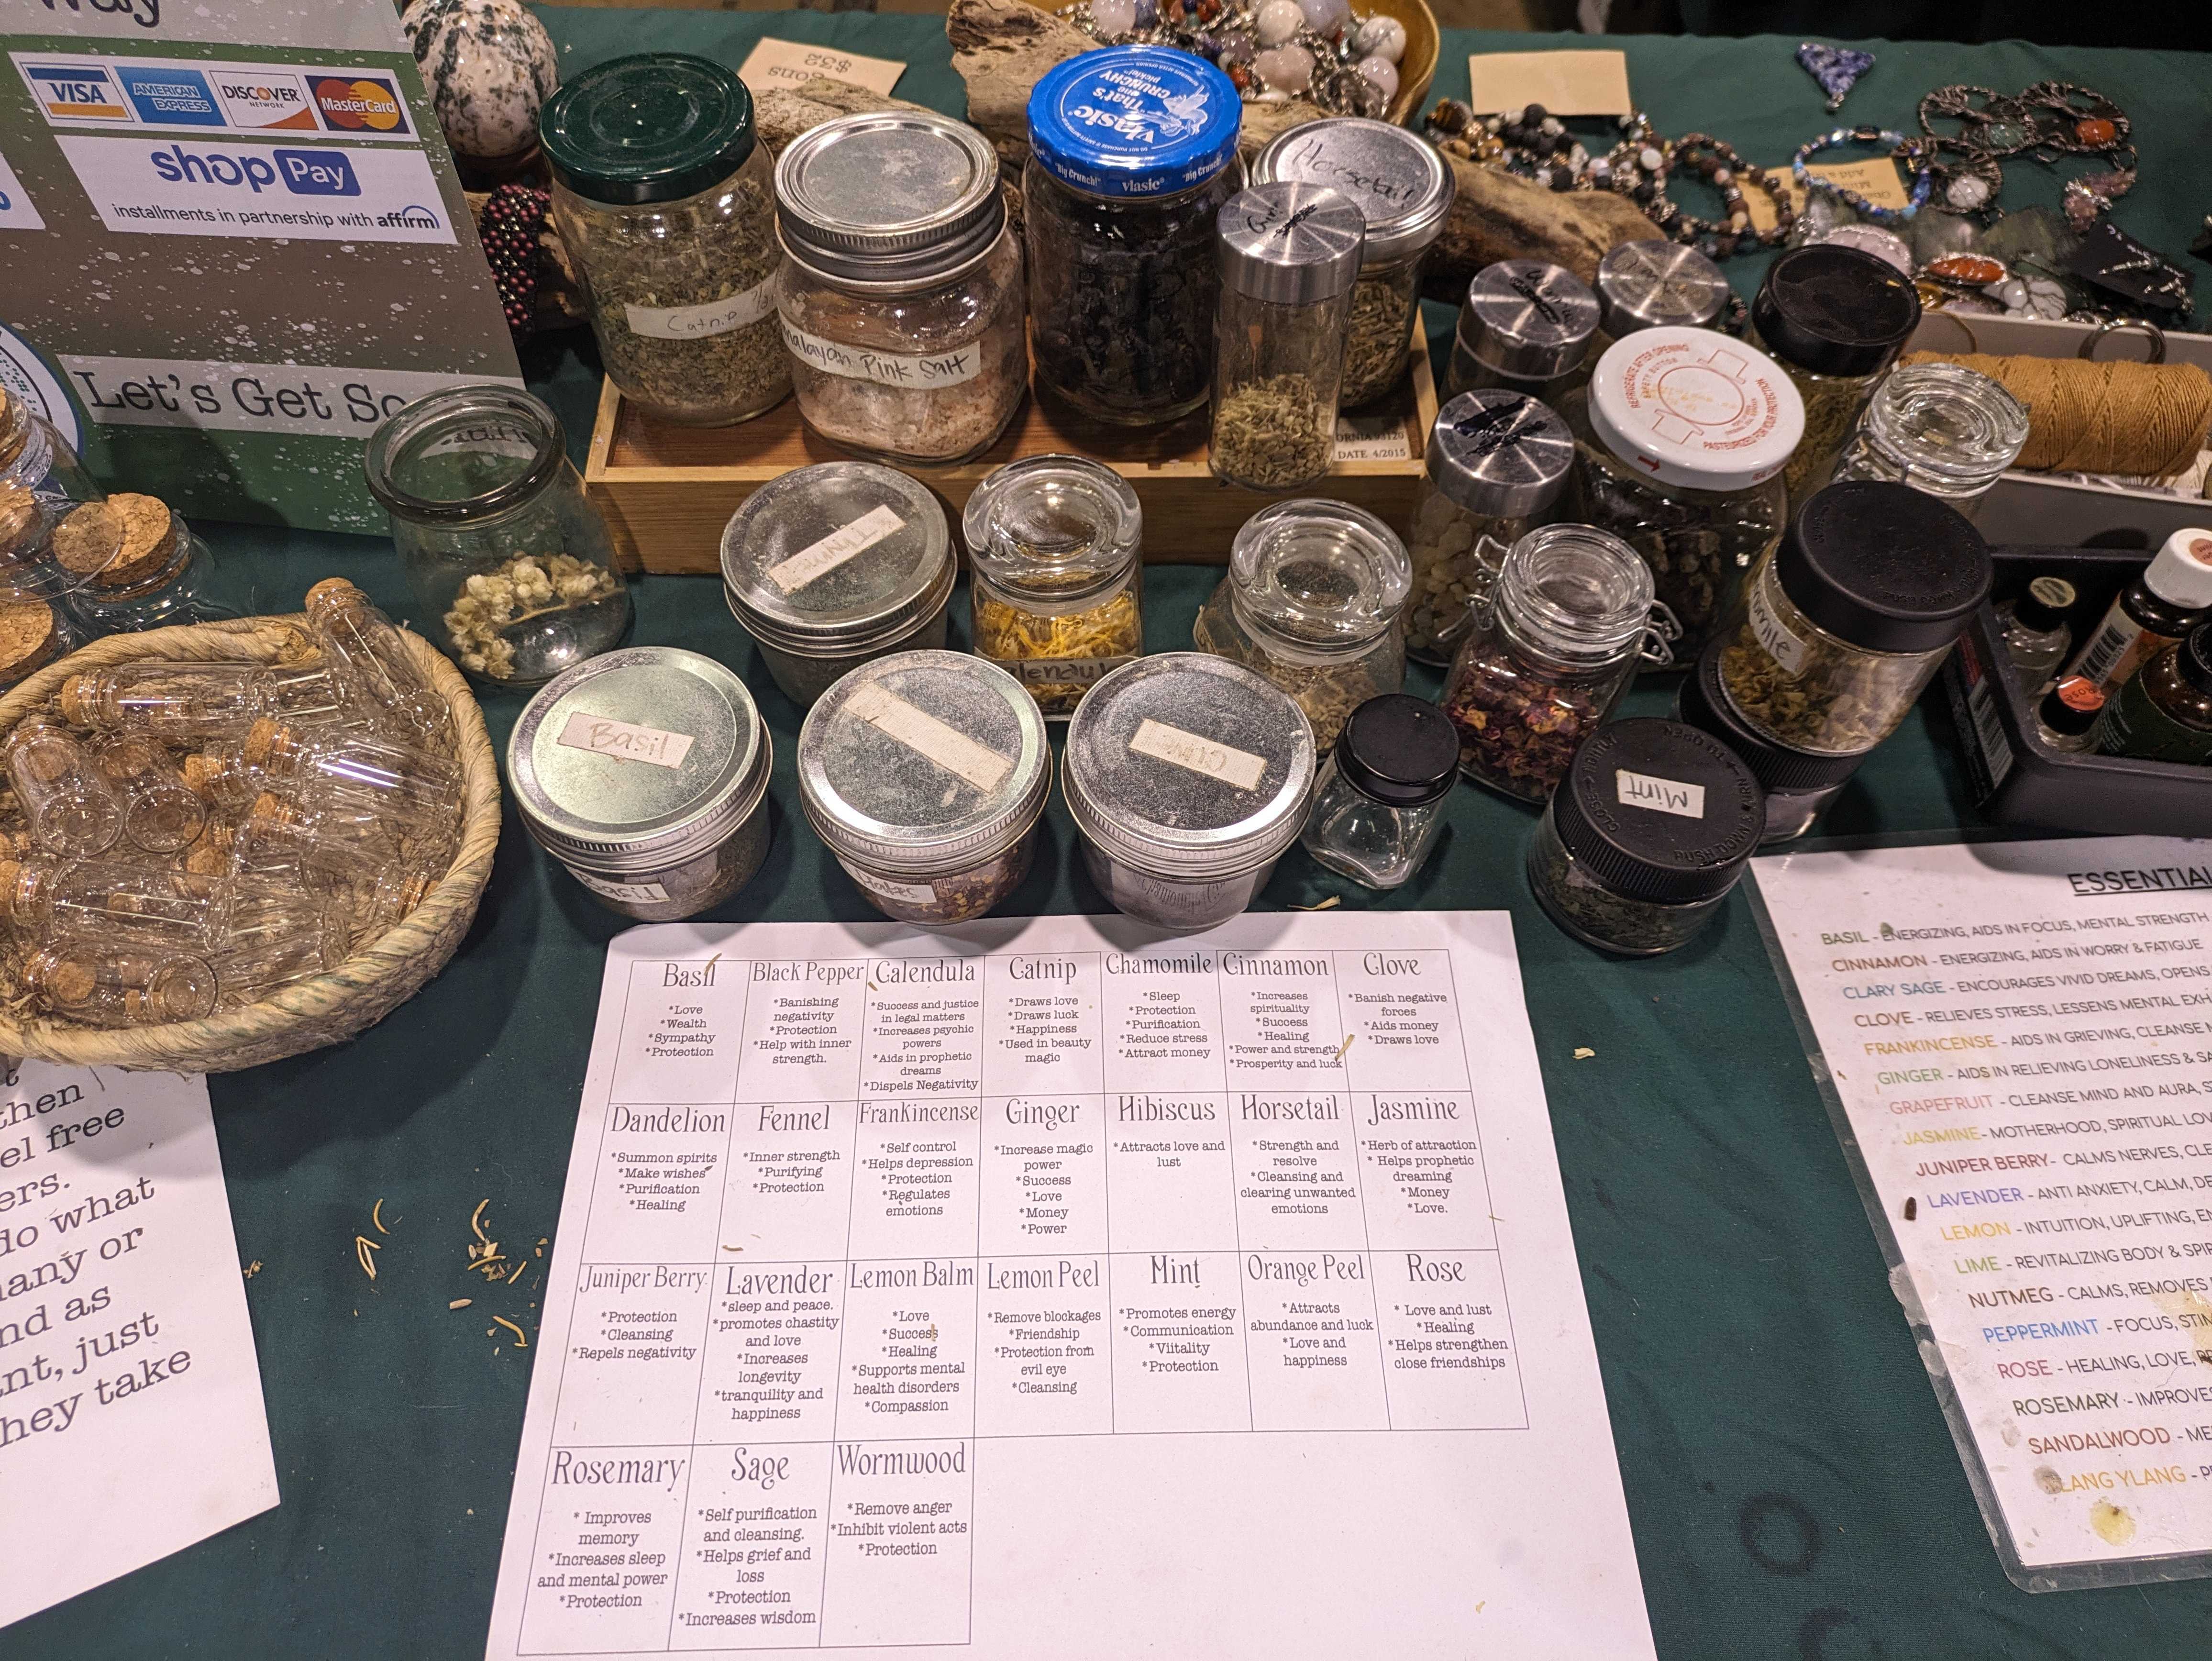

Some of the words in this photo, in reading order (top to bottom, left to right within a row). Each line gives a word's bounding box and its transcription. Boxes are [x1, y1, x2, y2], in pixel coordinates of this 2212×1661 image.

[49, 83, 105, 104] VISA
[133, 83, 198, 98] AMERICAN
[222, 85, 299, 102] DISCOVER
[1099, 70, 1171, 100] CRUNCHY
[156, 100, 210, 111] EXPRESS
[321, 97, 397, 114] MasterCard
[151, 145, 276, 193] shop
[286, 157, 344, 190] Pay
[112, 204, 214, 222] installments
[218, 209, 234, 221] in
[240, 210, 334, 229] partnership
[337, 213, 373, 227] with
[377, 208, 440, 229] affirm
[668, 311, 737, 332] Catnip
[860, 354, 913, 380] Pink
[919, 354, 970, 379] Salt
[73, 371, 222, 414] Let's
[232, 377, 332, 420] Get
[1338, 450, 1368, 460] DATE
[1372, 447, 1406, 458] 4/2015
[589, 722, 669, 760] Basil
[1625, 775, 1688, 809] Mint
[1820, 931, 1869, 945] BASIL
[1879, 926, 1970, 941] ENERGIZING,
[1972, 924, 2003, 936] AIDS
[2004, 924, 2021, 934] IN
[2021, 920, 2076, 933] FOCUS,
[2076, 917, 2135, 929] MENTAL
[2135, 912, 2210, 926] STRENGTH
[1106, 952, 1213, 974] Chamomile
[1223, 952, 1329, 975] Cinnamon
[1363, 952, 1421, 975] Clove
[1831, 955, 1928, 972] CINNAMON
[1939, 950, 2029, 965] ENERGIZING,
[2030, 948, 2062, 960] AIDS
[2063, 947, 2080, 957] IN
[2080, 944, 2128, 956] WORRY
[2132, 943, 2145, 953] &
[2144, 939, 2203, 953] FATIGUE
[663, 962, 715, 987] Basil
[753, 963, 800, 981] Black
[805, 962, 864, 986] Pepper
[876, 959, 975, 983] Calendula
[1009, 957, 1076, 985] Catnip
[1843, 985, 1895, 999] CLARY
[1900, 981, 1946, 995] SAGE
[1957, 974, 2056, 992] ENCOURAGES
[2056, 974, 2094, 986] VIVID
[2096, 969, 2160, 984] DREAMS,
[2161, 965, 2211, 979] OPENS
[774, 1011, 835, 1023] negativity
[1250, 1004, 1310, 1015] spirituality
[1381, 1007, 1416, 1016] forces
[1854, 1011, 1914, 1027] CLOVE
[1924, 1008, 1993, 1022] RELIEVES
[1995, 1005, 2052, 1019] STRESS,
[2052, 1000, 2118, 1015] LESSENS
[2119, 996, 2180, 1009] MENTAL
[1864, 1035, 1998, 1055] FRANKINCENSE
[773, 1053, 827, 1065] strength.
[900, 1067, 941, 1075] dreams
[1877, 1068, 1944, 1085] GINGER
[859, 1102, 979, 1123] Frankincense
[1006, 1098, 1080, 1131] Ginger
[1118, 1096, 1215, 1121] Hibiscus
[1240, 1094, 1339, 1120] Horsetail
[1368, 1094, 1460, 1126] Jasmine
[1890, 1095, 1992, 1114] GRAPEFRUIT
[46, 1108, 124, 1153] free
[610, 1107, 725, 1132] Dandelion
[757, 1105, 830, 1131] Fennel
[1393, 1171, 1452, 1183] dreaming
[1916, 1158, 1993, 1177] JUNIPER
[49, 1177, 155, 1233] what
[1927, 1187, 2024, 1208] LAVENDER
[886, 1205, 943, 1217] emotions
[1940, 1222, 2012, 1240] LEMON
[100, 1228, 144, 1260] or
[850, 1263, 917, 1289] Lemon
[922, 1261, 973, 1286] Balm
[988, 1262, 1053, 1290] Lemon
[1058, 1260, 1099, 1287] Peel
[1150, 1255, 1200, 1284] Mint
[1248, 1254, 1318, 1287] Orange
[1322, 1254, 1365, 1280] Peel
[1405, 1253, 1466, 1282] Rose
[1954, 1256, 2002, 1274] LIME
[579, 1266, 651, 1294] Juniper
[653, 1265, 707, 1293] Berry
[726, 1265, 833, 1296] Lavender
[65, 1286, 111, 1321] as
[1968, 1287, 2054, 1308] NUTMEG
[72, 1312, 159, 1374] just
[1982, 1319, 2098, 1343] PEPPERMINT
[1394, 1357, 1427, 1369] close
[1430, 1356, 1505, 1370] friendships
[1997, 1360, 2053, 1379] ROSE
[94, 1351, 190, 1405] take
[738, 1371, 802, 1385] longevity
[2012, 1392, 2119, 1416] ROSEMARY
[2028, 1427, 2170, 1455] SANDALWOOD
[731, 1447, 790, 1490] Sage
[837, 1441, 966, 1475] Wormwood
[551, 1451, 686, 1492] Rosemary
[2115, 1465, 2187, 1487] YLANG
